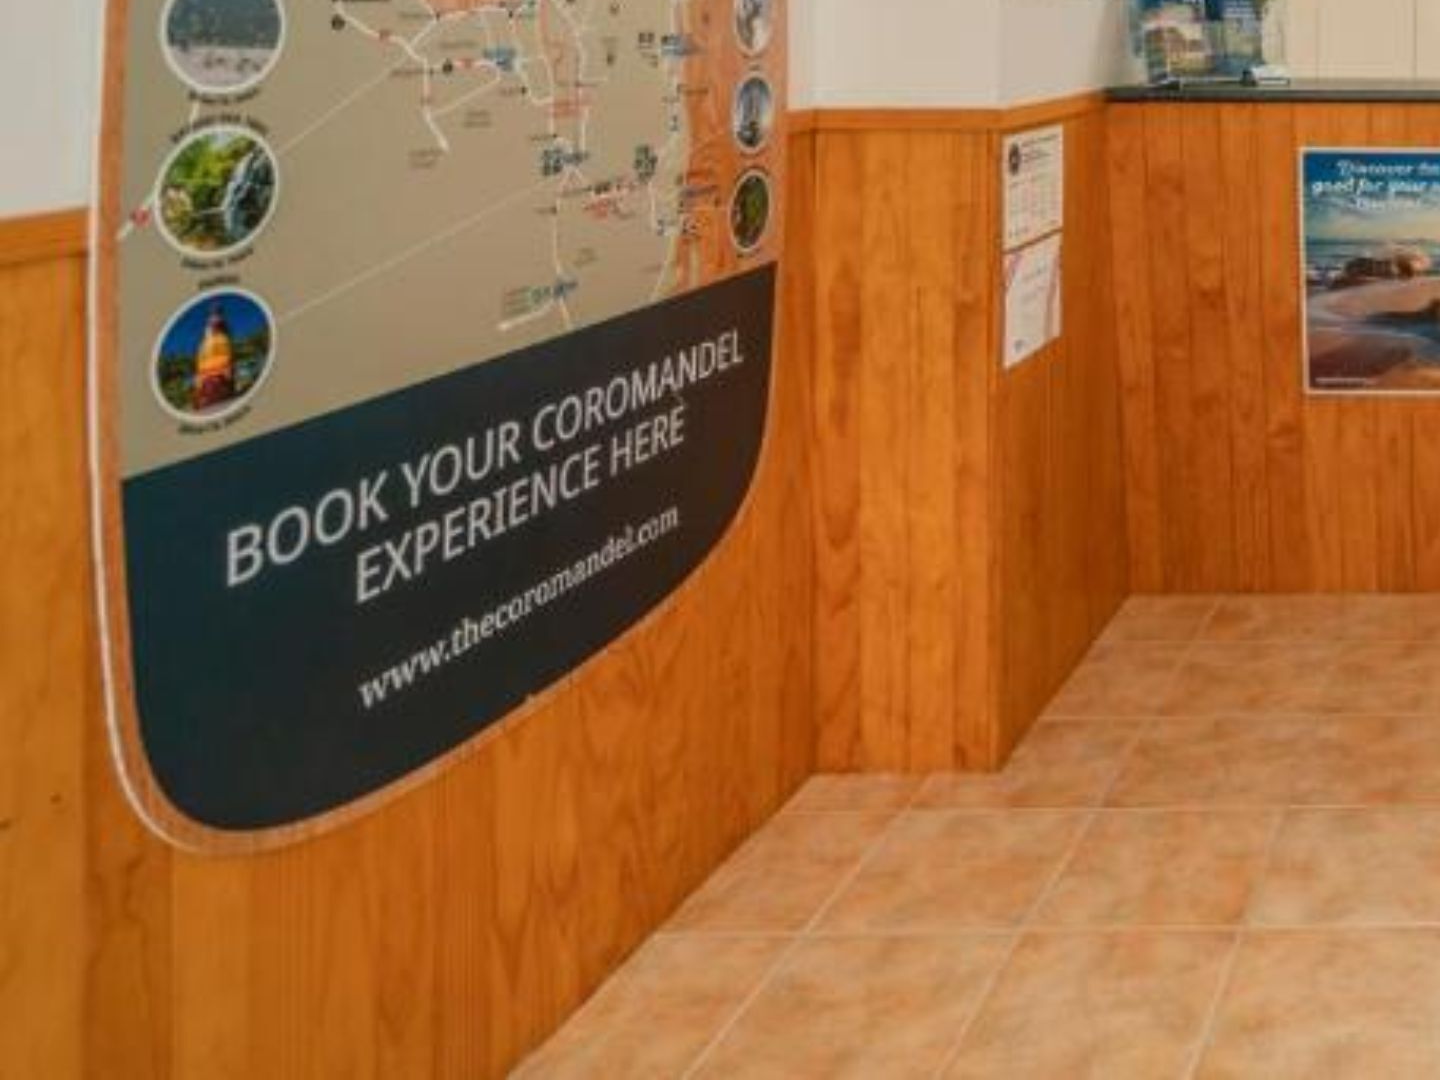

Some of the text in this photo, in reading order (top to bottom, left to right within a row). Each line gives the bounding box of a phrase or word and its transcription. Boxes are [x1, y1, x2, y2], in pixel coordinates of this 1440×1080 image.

[1312, 177, 1354, 196] good
[226, 328, 745, 588] BOOK YOUR COROMANDEL
[355, 405, 686, 604] EXPERIENCE HERE
[357, 505, 680, 711] www.thecoromandel.com
